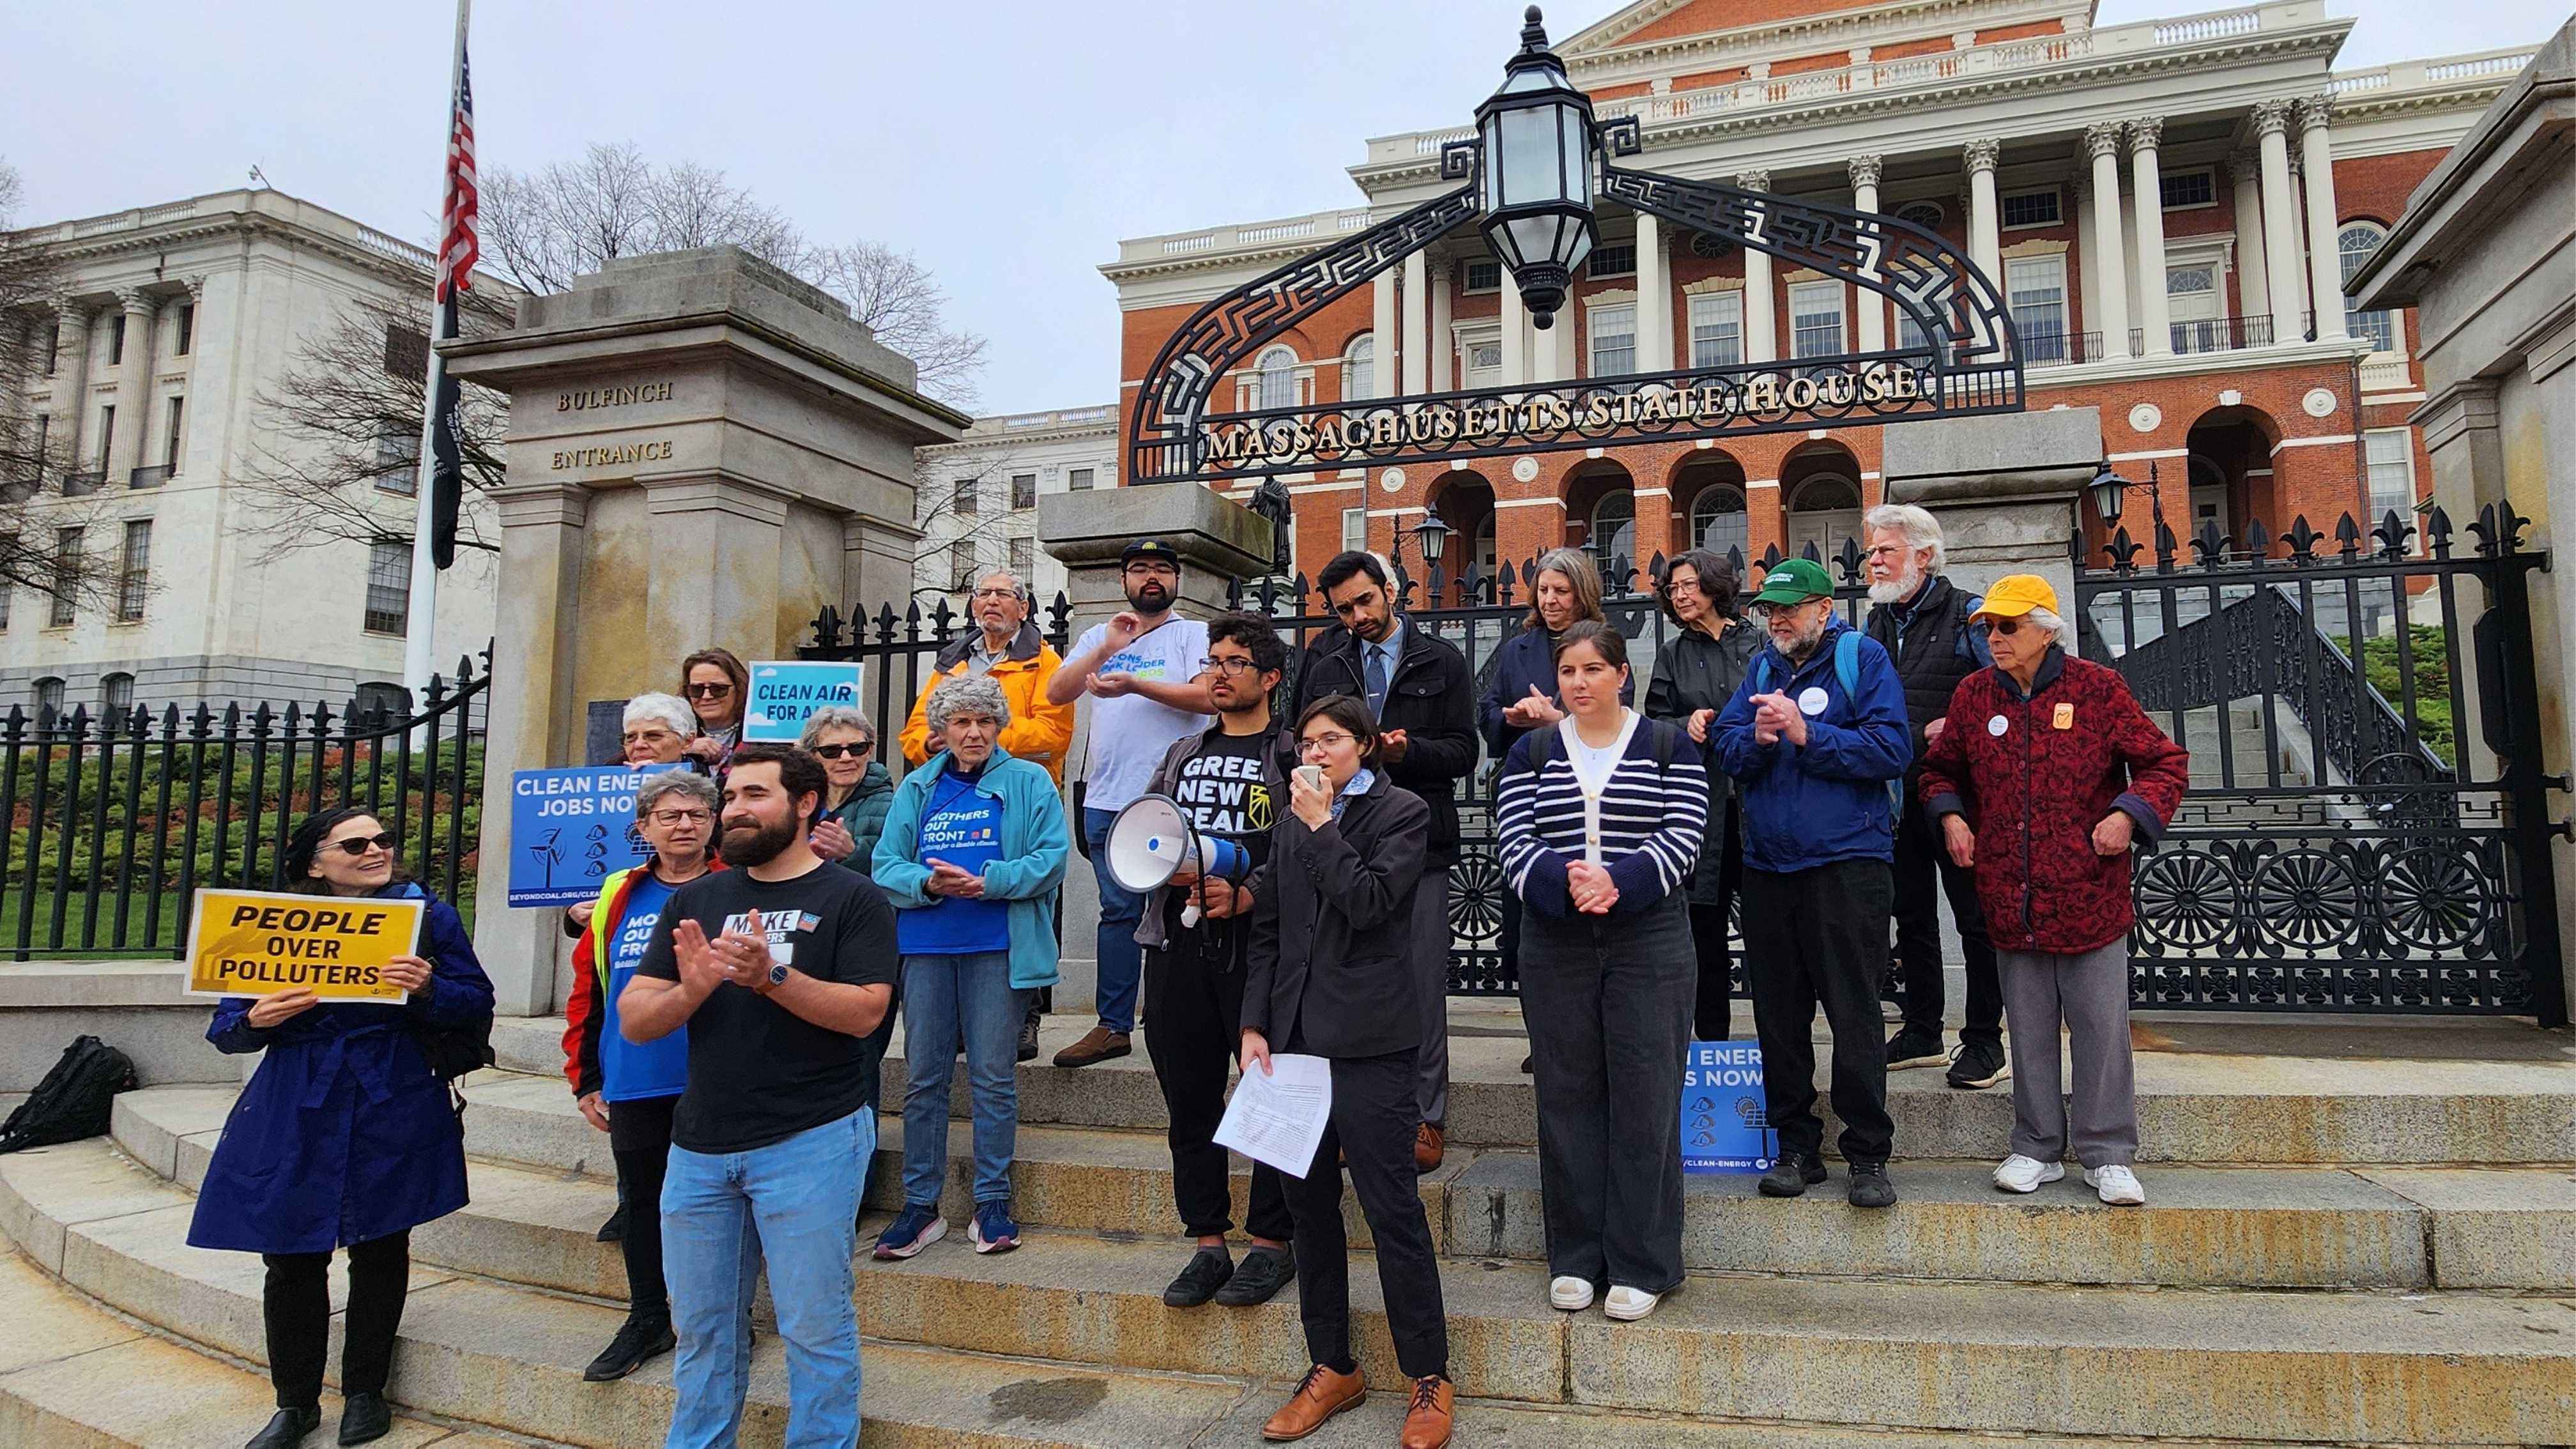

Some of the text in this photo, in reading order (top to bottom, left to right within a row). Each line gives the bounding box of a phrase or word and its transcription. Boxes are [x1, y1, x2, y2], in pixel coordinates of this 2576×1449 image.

[557, 382, 673, 411] BULFINCH
[1207, 368, 1916, 460] MASSACHUSETTS STATE HOUSE
[551, 441, 673, 469] ENTRANCE
[758, 684, 852, 702] CLEAN AIR
[767, 705, 820, 720] FOR A
[1183, 756, 1265, 783] GREE
[516, 776, 590, 796] CLEAN
[1177, 779, 1245, 806] NEW
[537, 796, 637, 817] JOBS NO
[923, 831, 966, 843] FRONT
[924, 821, 950, 832] OUT
[231, 905, 387, 936] PEOPLE
[627, 913, 661, 929] MO
[266, 936, 341, 959] OVER
[219, 959, 379, 985] POLLUTERS
[1706, 1070, 1763, 1086] NOW
